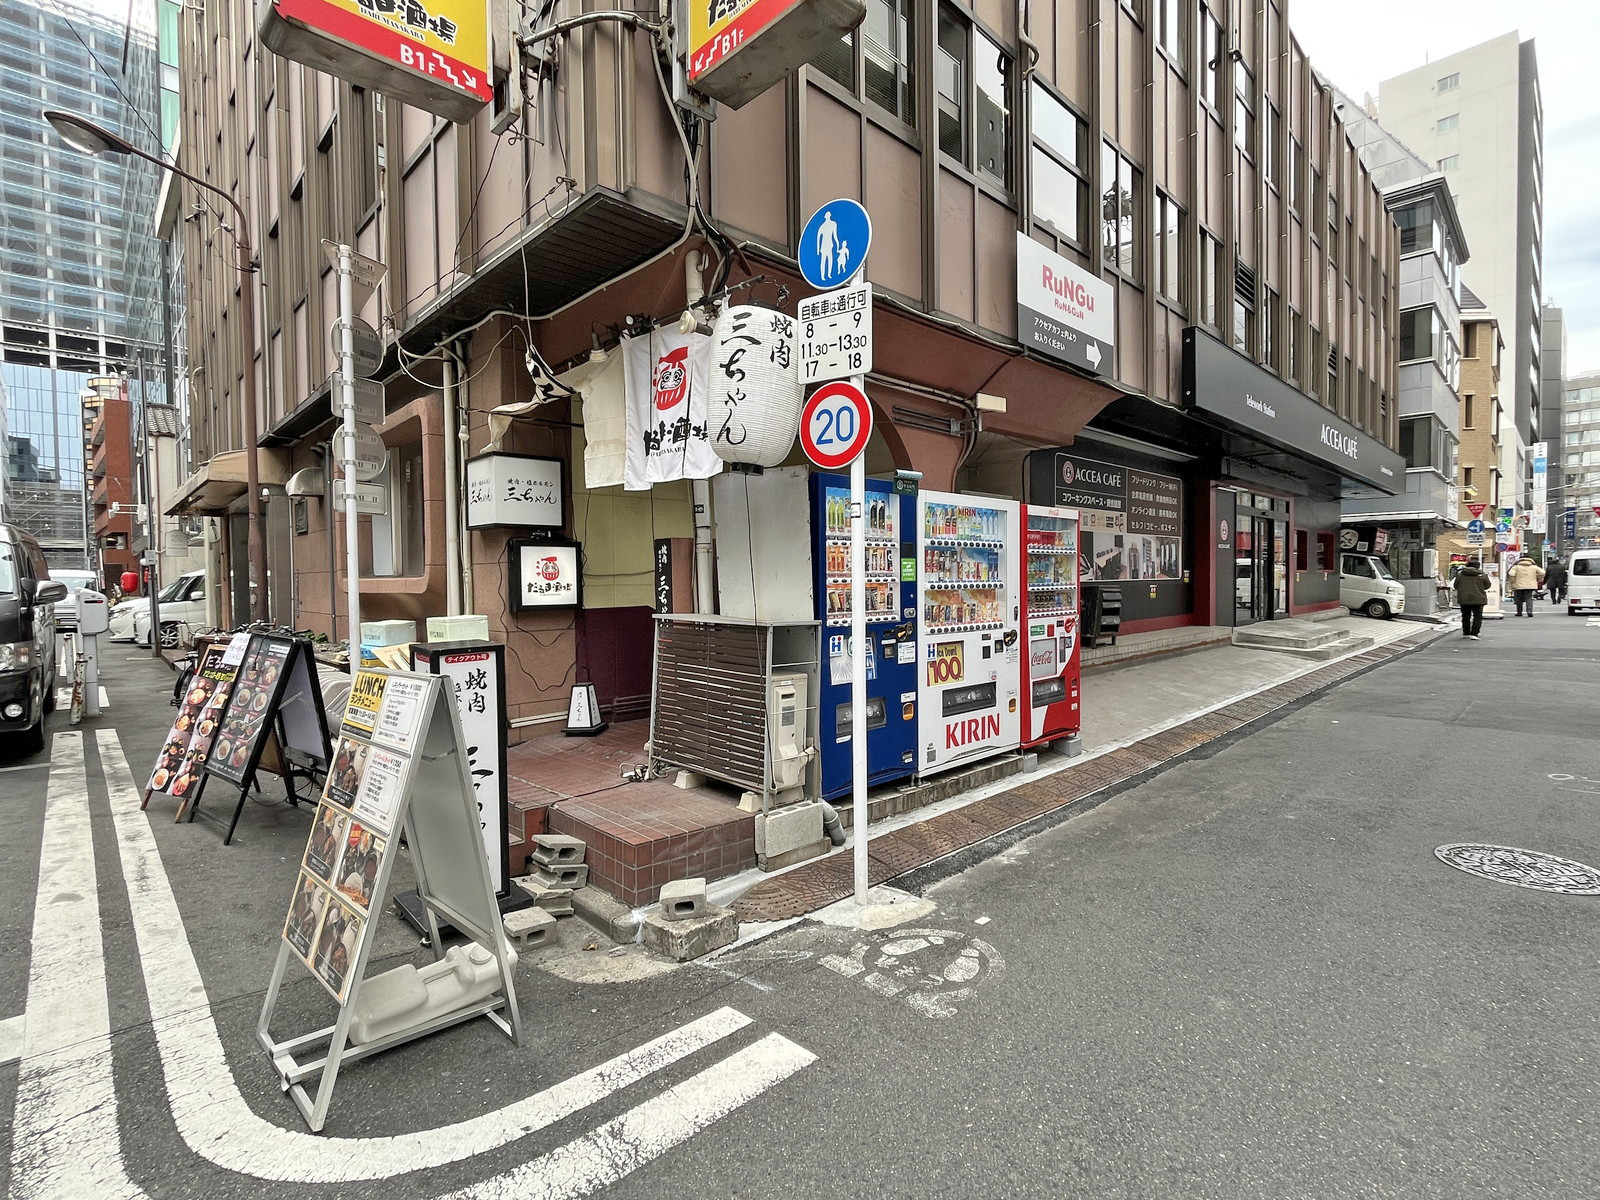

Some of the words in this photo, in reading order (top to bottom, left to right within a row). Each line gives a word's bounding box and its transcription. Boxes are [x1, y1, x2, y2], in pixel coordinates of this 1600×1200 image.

[722, 28, 744, 56] B1F
[400, 44, 436, 74] B1F
[801, 290, 867, 320] 自転車は通行可
[769, 314, 793, 370] 焼肉
[1034, 331, 1066, 351] お入りください
[716, 311, 762, 445] 三ちゃん
[815, 405, 854, 446] 20
[1320, 423, 1342, 453] ACCEA
[1343, 436, 1358, 460] CAFÉ
[1075, 468, 1101, 484] ACCEA
[1103, 472, 1121, 488] CAFÉ
[503, 487, 557, 505] 三ちゃん
[447, 653, 488, 663] テイクアウト可
[350, 693, 375, 708] ランチメニュー
[353, 674, 387, 698] LUNCH
[464, 668, 488, 714] 焼肉
[945, 713, 1000, 749] KIRIN
